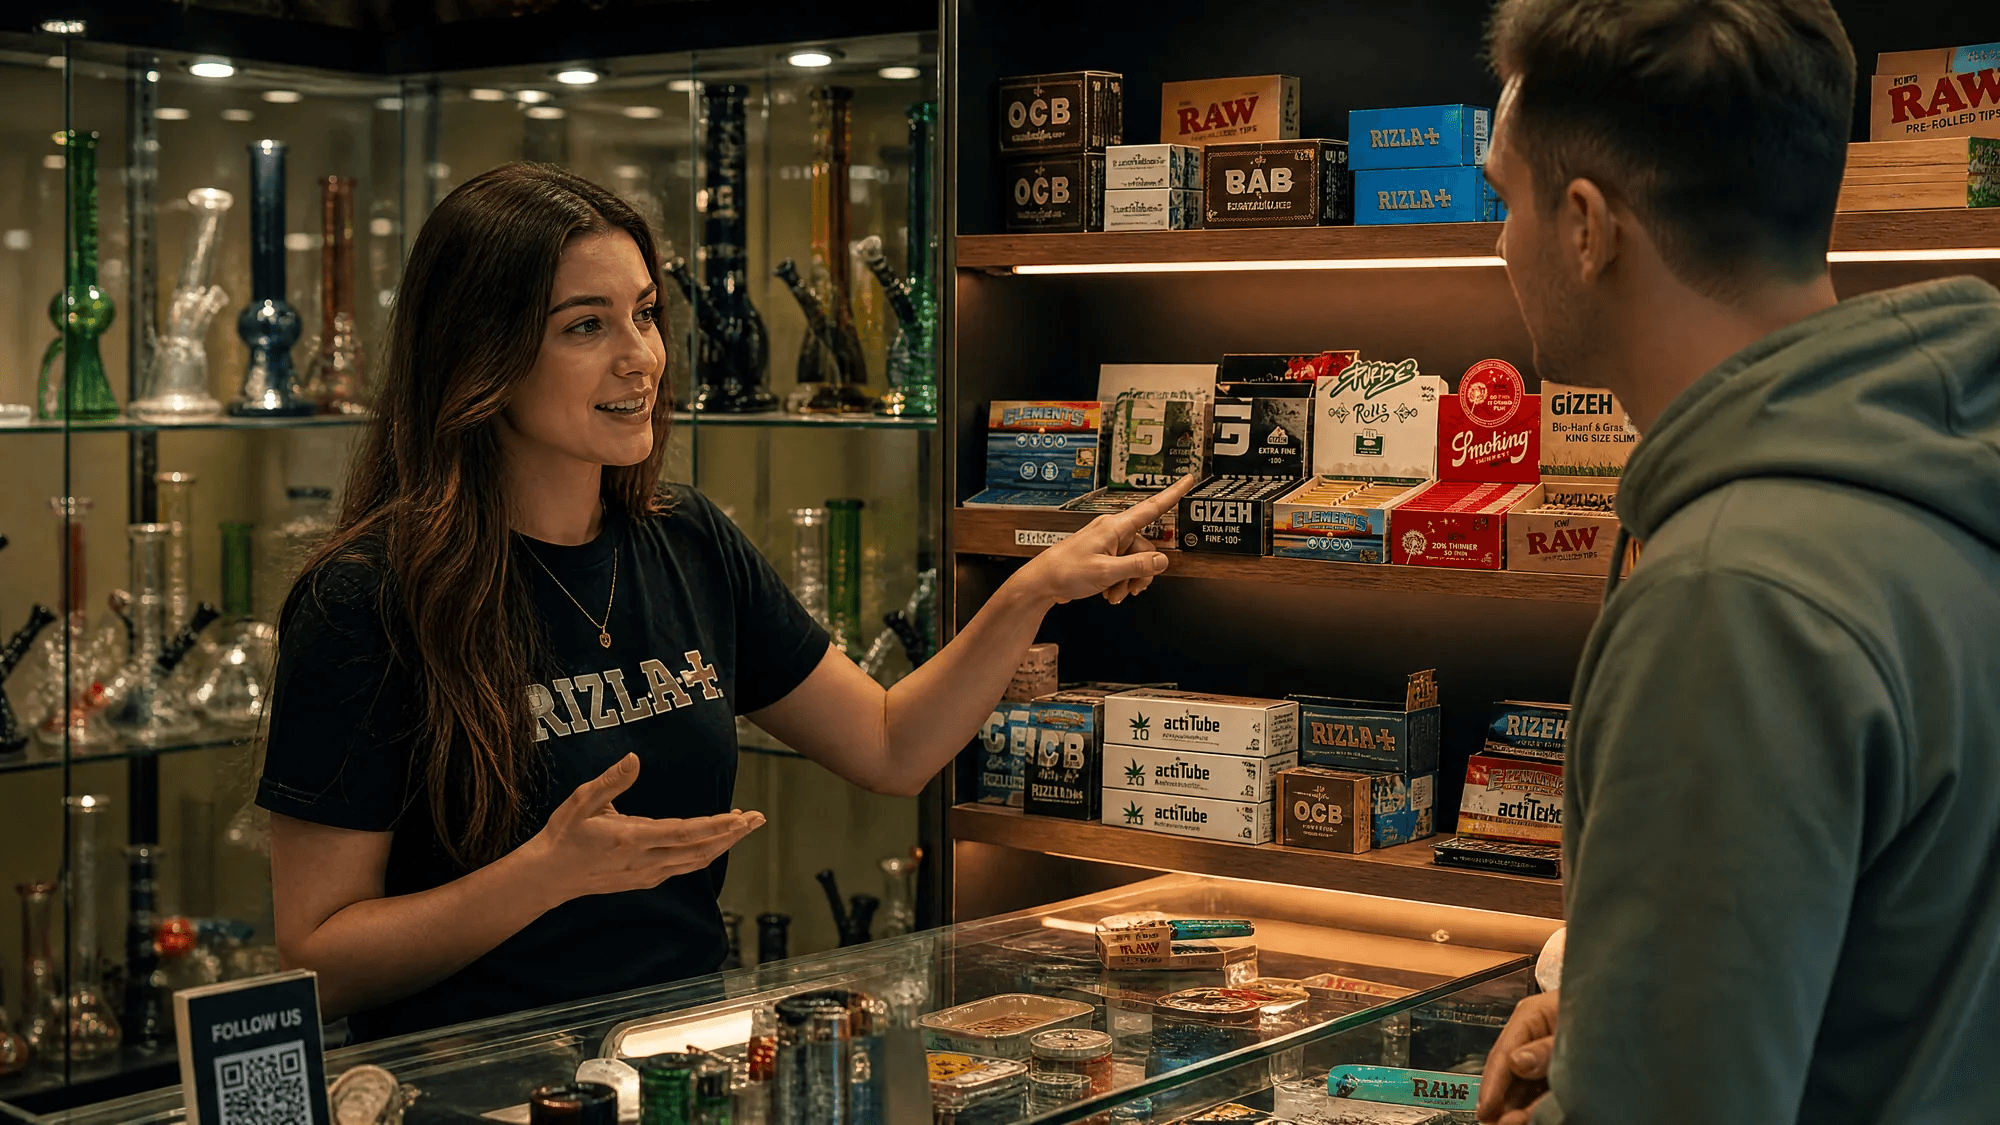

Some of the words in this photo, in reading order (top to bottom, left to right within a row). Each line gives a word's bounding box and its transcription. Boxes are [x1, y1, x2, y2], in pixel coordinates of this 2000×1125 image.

[1888, 67, 2000, 124] RAW
[1008, 97, 1070, 129] OCB
[1177, 95, 1259, 135] RAW
[1906, 112, 1976, 134] PRE-ROLLED
[1370, 127, 1440, 148] RIZLA+
[1014, 176, 1070, 206] OCB
[1225, 167, 1295, 195] BAB
[1377, 178, 1452, 210] RIZLA+
[1003, 407, 1085, 427] ELEMENTS
[1552, 422, 1593, 432] Bio-Hanf
[1602, 422, 1624, 432] Gras
[1451, 430, 1529, 467] Smoking
[1565, 434, 1589, 443] KING
[1591, 434, 1611, 443] SIZE
[1613, 434, 1635, 443] SLIM
[1258, 447, 1280, 455] EXTRA
[1280, 447, 1297, 455] FINE
[1190, 501, 1253, 524] GIZEH
[1291, 510, 1369, 533] ELEMENTS
[1202, 525, 1223, 534] EXTRA
[1224, 525, 1241, 534] FINE
[1526, 526, 1600, 555] RAW
[1163, 714, 1220, 733] actiTube
[1311, 721, 1396, 752] RIZLA+
[1155, 762, 1210, 781] actiTube
[1154, 805, 1208, 824] actiTube
[1293, 800, 1343, 825] OCB
[211, 1012, 277, 1043] FOLLOW
[279, 1008, 302, 1027] US
